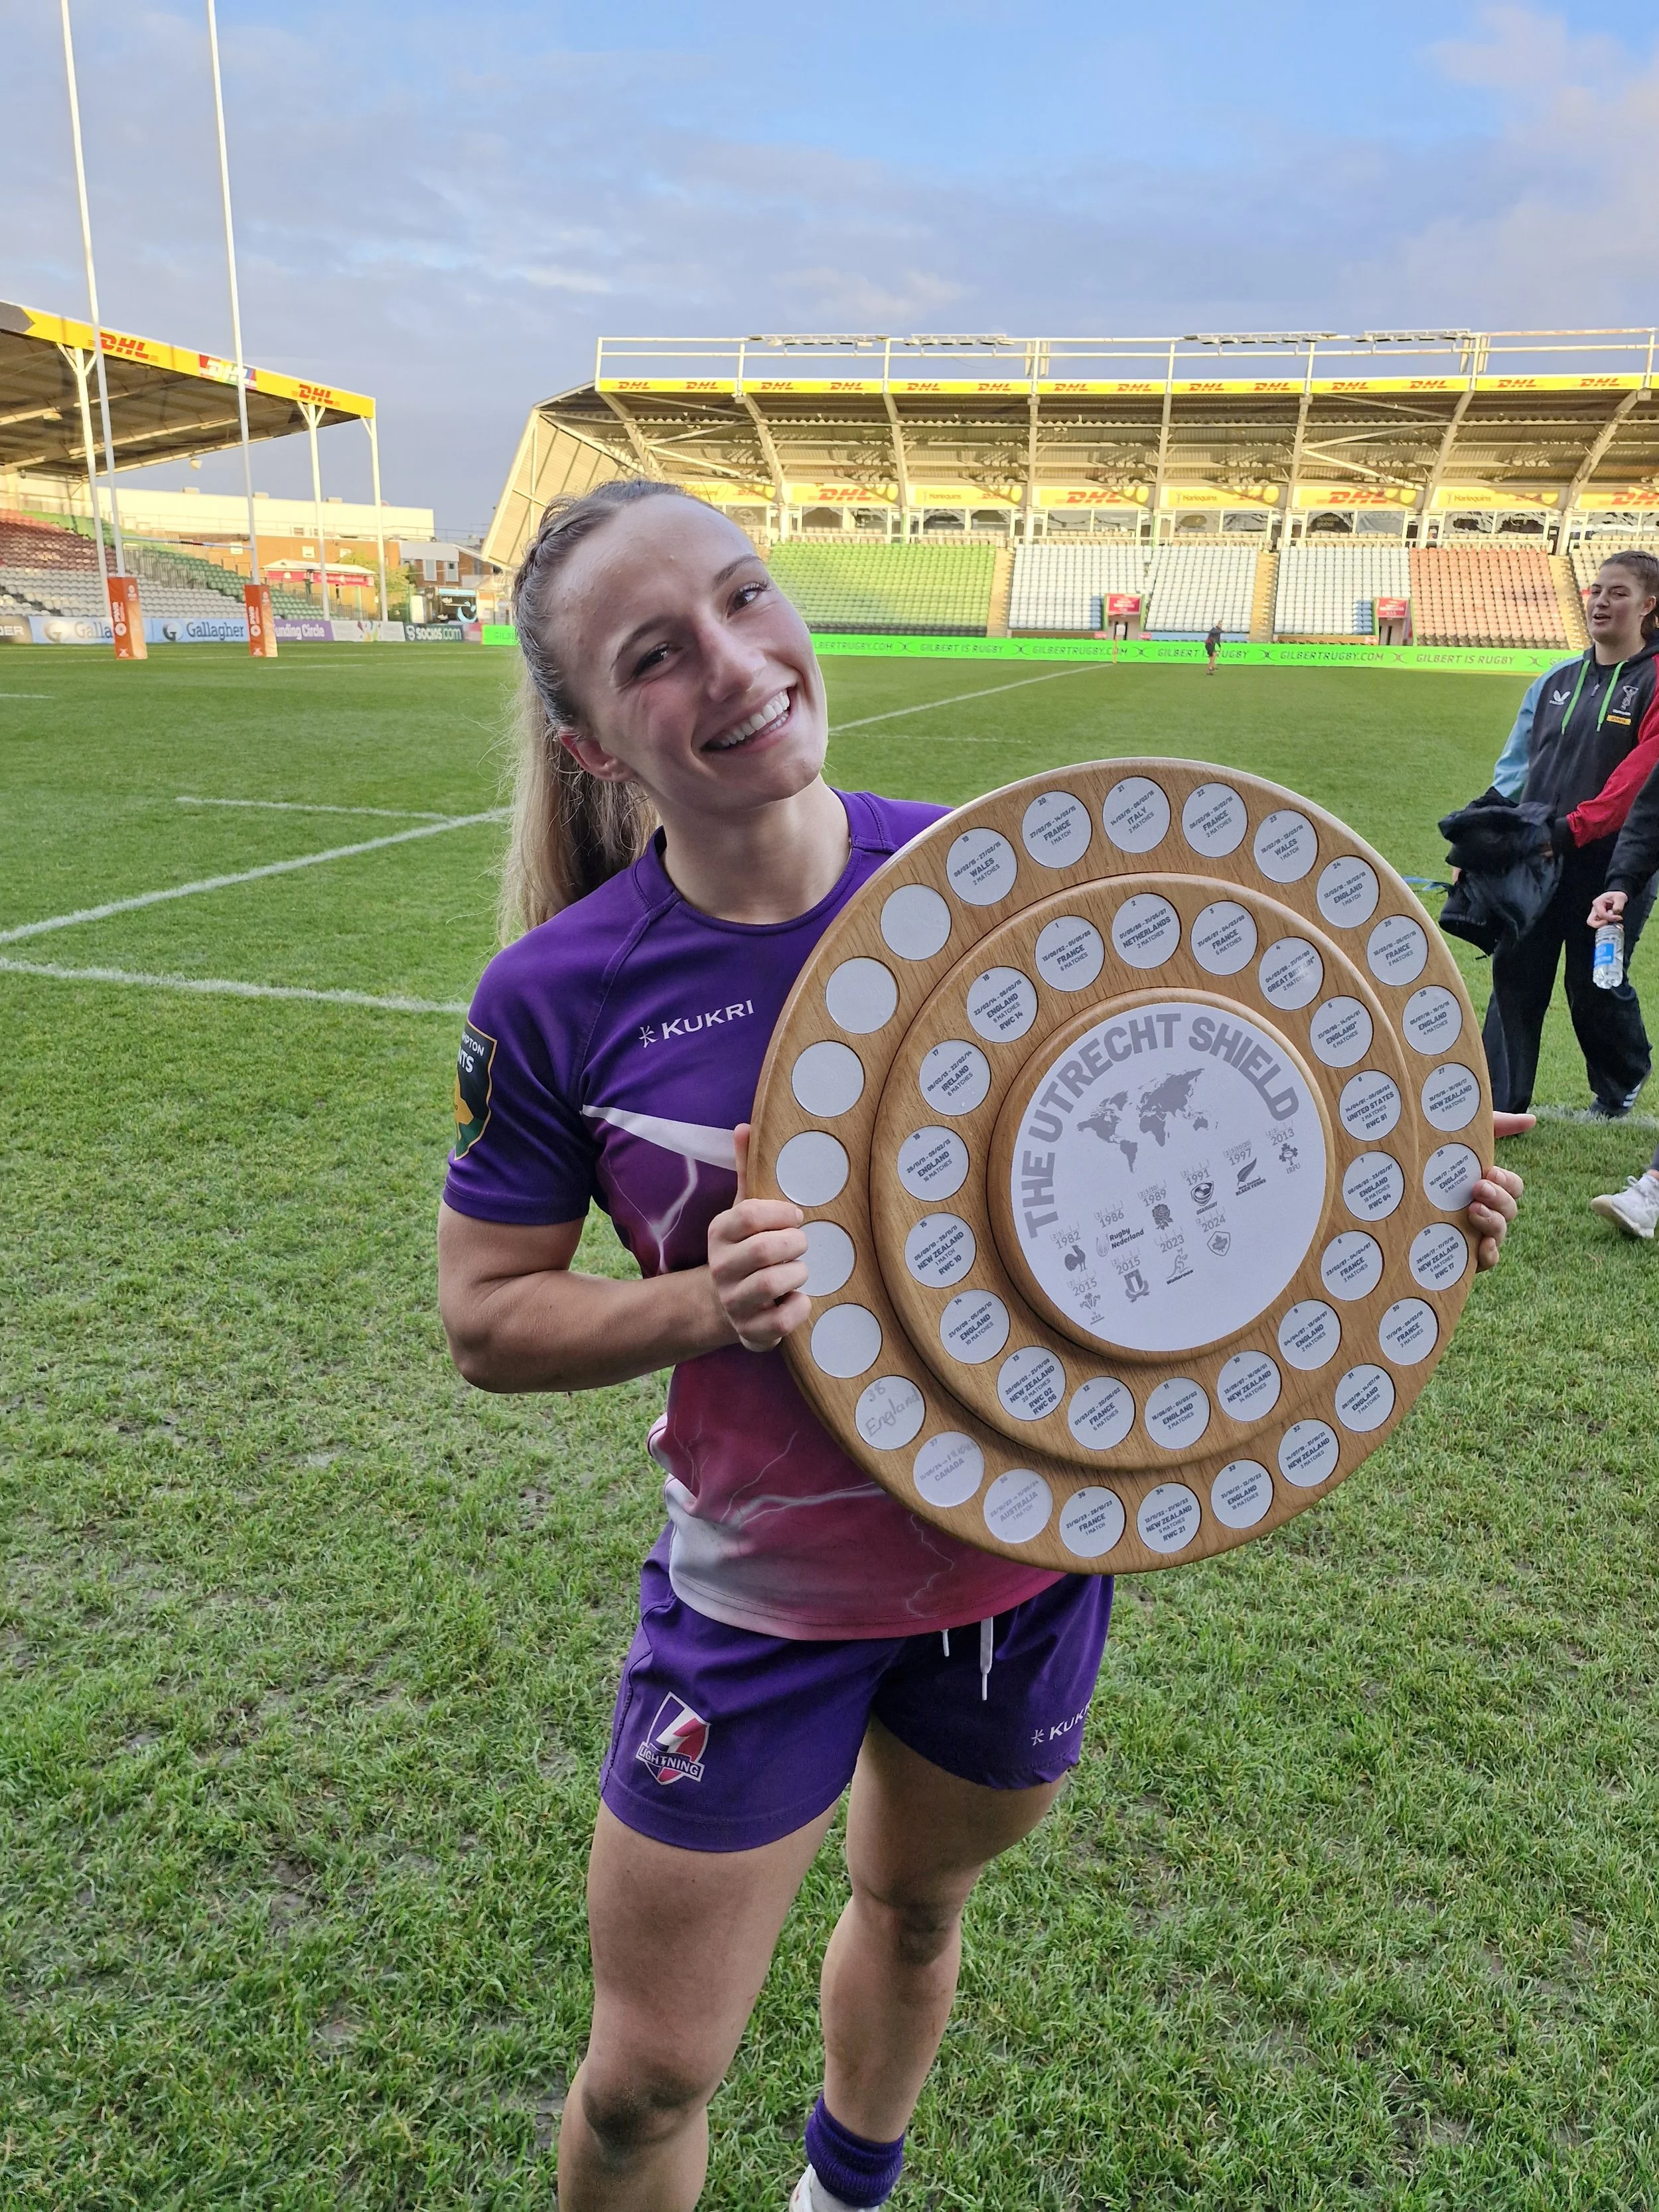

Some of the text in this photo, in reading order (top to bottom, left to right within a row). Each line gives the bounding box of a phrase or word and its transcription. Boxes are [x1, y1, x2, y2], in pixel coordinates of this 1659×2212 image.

[100, 332, 149, 359] DHL
[1332, 382, 1368, 390] DHL
[1410, 381, 1447, 389] DHL
[1498, 380, 1537, 388] DHL
[1580, 378, 1620, 387] DHL
[299, 384, 333, 404] DHL
[818, 488, 873, 501] DHL
[1066, 492, 1122, 503] DHL
[1328, 492, 1388, 504] DHL
[1611, 492, 1659, 505] DH
[75, 622, 113, 638] Galla
[186, 622, 244, 640] Gallagher
[274, 624, 302, 640] unding
[920, 643, 959, 652] GILBERT
[972, 644, 1004, 654] RUGBY
[1157, 649, 1200, 658] GILBERT
[1280, 650, 1384, 662] GILBERTRUGBY.COM
[1416, 653, 1516, 665] GILBERT IS RUGBY
[1117, 784, 1125, 793] 21
[1196, 789, 1206, 798] 22
[1037, 797, 1047, 806] 20
[1126, 806, 1146, 825] ITALY
[1202, 809, 1229, 831] FRANCE
[1269, 815, 1278, 824] 23
[1043, 819, 1071, 841] FRANCE
[1274, 838, 1298, 856] WALES
[969, 857, 995, 877] WALES
[976, 864, 1000, 882] MATCHES
[1333, 882, 1363, 904] ENGLAND
[1122, 916, 1171, 949] NETHERLANDS
[1211, 928, 1239, 950] FRANCE
[1056, 944, 1085, 965] FRANCE
[1385, 942, 1411, 960] FRANCE
[1267, 974, 1288, 992] GREAT
[986, 992, 1018, 1019] ENGLAND
[661, 999, 755, 1040] KUKRI
[999, 1016, 1015, 1030] RWC
[1417, 1011, 1447, 1031] ENGLAND
[941, 1065, 969, 1092] IRELAND
[1347, 1091, 1394, 1121] UNITED STATES
[1429, 1085, 1472, 1111] NEW ZEALAND
[1021, 1013, 1299, 1239] THE UTRECHT SHIELD
[1365, 1117, 1380, 1129] RWC
[1271, 1128, 1295, 1146] 2013
[917, 1151, 950, 1177] ENGLAND
[1229, 1148, 1252, 1166] 1997
[1186, 1169, 1211, 1186] 1991
[1286, 1163, 1301, 1174] IRFU
[1439, 1166, 1466, 1189] ENGLAND
[1235, 1178, 1266, 1196] BLACK FERNS
[1359, 1176, 1388, 1198] ENGLAND
[1143, 1189, 1166, 1207] 1989
[1368, 1198, 1383, 1210] RWC
[1100, 1210, 1124, 1228] 1986
[1202, 1215, 1226, 1233] 2024
[1056, 1231, 1081, 1249] 1982
[1109, 1228, 1130, 1241] Rugby
[1111, 1228, 1145, 1249] Nederland
[1161, 1234, 1184, 1253] 2023
[917, 1231, 964, 1270] NEW ZEALAND
[1417, 1242, 1459, 1273] NEW ZEALAND
[938, 1254, 961, 1275] RWC 10
[1116, 1256, 1140, 1275] 2015
[1339, 1256, 1365, 1277] FRANCE
[1434, 1267, 1448, 1279] RWC
[1166, 1269, 1193, 1285] Wallaroos
[1072, 1278, 1097, 1296] 2015
[953, 1298, 963, 1306] 14
[959, 1313, 991, 1341] ENGLAND
[1295, 1323, 1324, 1348] ENGLAND
[1396, 1322, 1420, 1343] FRANCE
[1011, 1353, 1020, 1362] 13
[1009, 1365, 1054, 1403] NEW ZEALAND
[1347, 1371, 1355, 1380] 31
[866, 1381, 886, 1402] 38
[1082, 1384, 1091, 1393] 12
[1227, 1370, 1271, 1403] NEW ZEALAND
[1028, 1387, 1053, 1409] RWC 02
[1032, 1393, 1057, 1415] RWC 06
[1351, 1386, 1378, 1411] ENGLAND
[865, 1387, 920, 1438] England
[1089, 1401, 1115, 1425] FRANCE
[1162, 1402, 1193, 1425] ENGLAND
[1293, 1425, 1301, 1433] 32
[1287, 1438, 1330, 1470] NEW ZEALAND
[934, 1458, 965, 1482] CANADA
[1227, 1484, 1257, 1505] ENGLAND
[1000, 1491, 1038, 1522] AUSTRALIA
[1078, 1512, 1106, 1532] FRANCE
[1146, 1505, 1192, 1533] NEW ZEALAND
[1163, 1525, 1186, 1541] RWC 21
[639, 1746, 698, 1776] LIGHTNING
